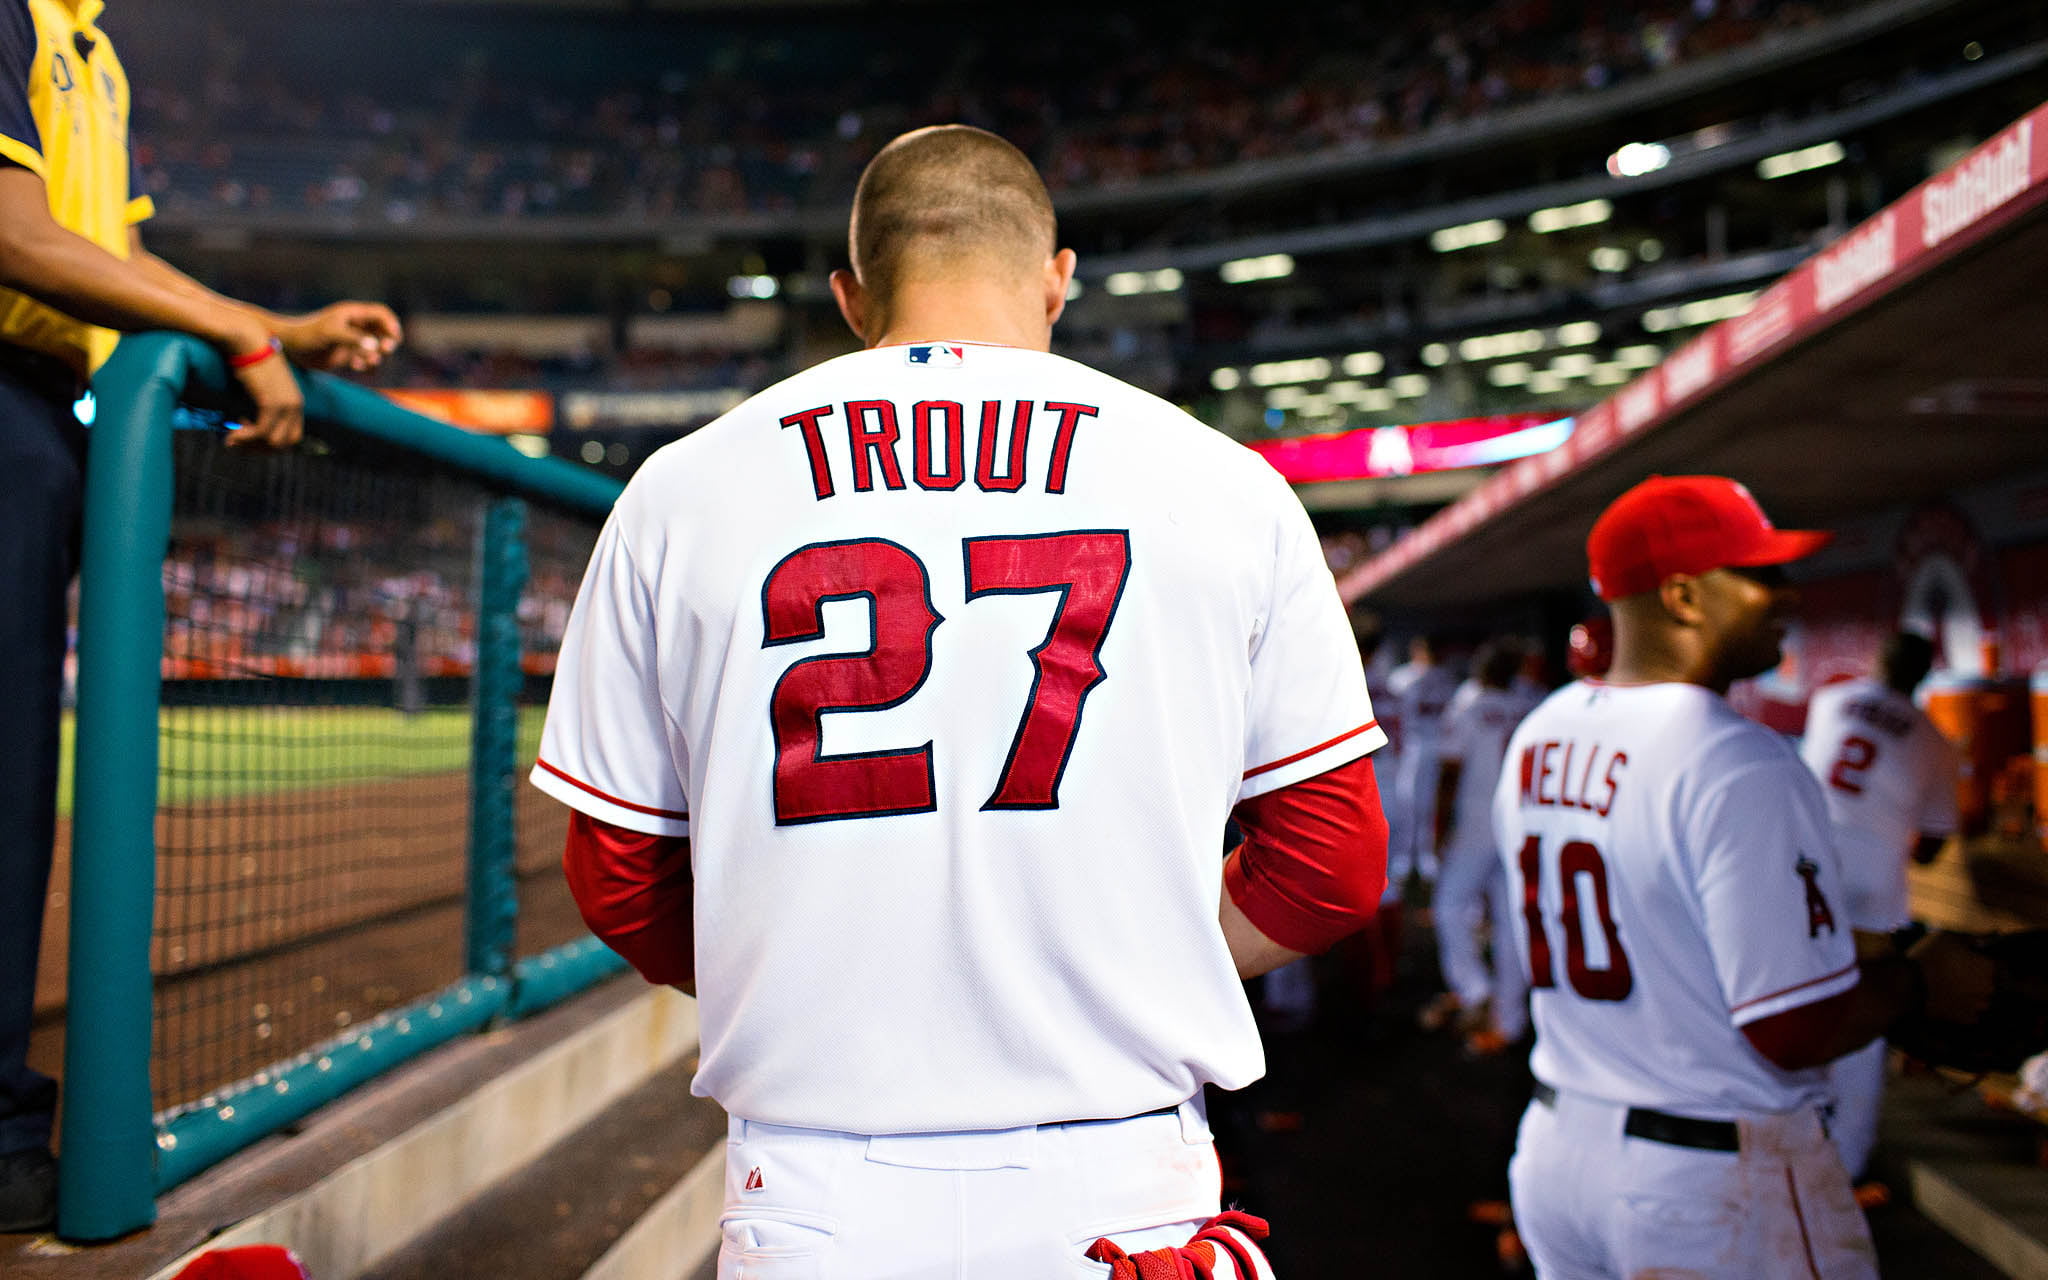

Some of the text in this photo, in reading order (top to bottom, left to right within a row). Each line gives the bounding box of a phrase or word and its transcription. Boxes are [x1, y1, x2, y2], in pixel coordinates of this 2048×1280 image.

[780, 400, 1099, 500] TROUT
[761, 529, 1132, 826] 27
[1518, 738, 1628, 818] WELLS
[1829, 735, 1877, 796] 2
[1517, 834, 1633, 1003] 10
